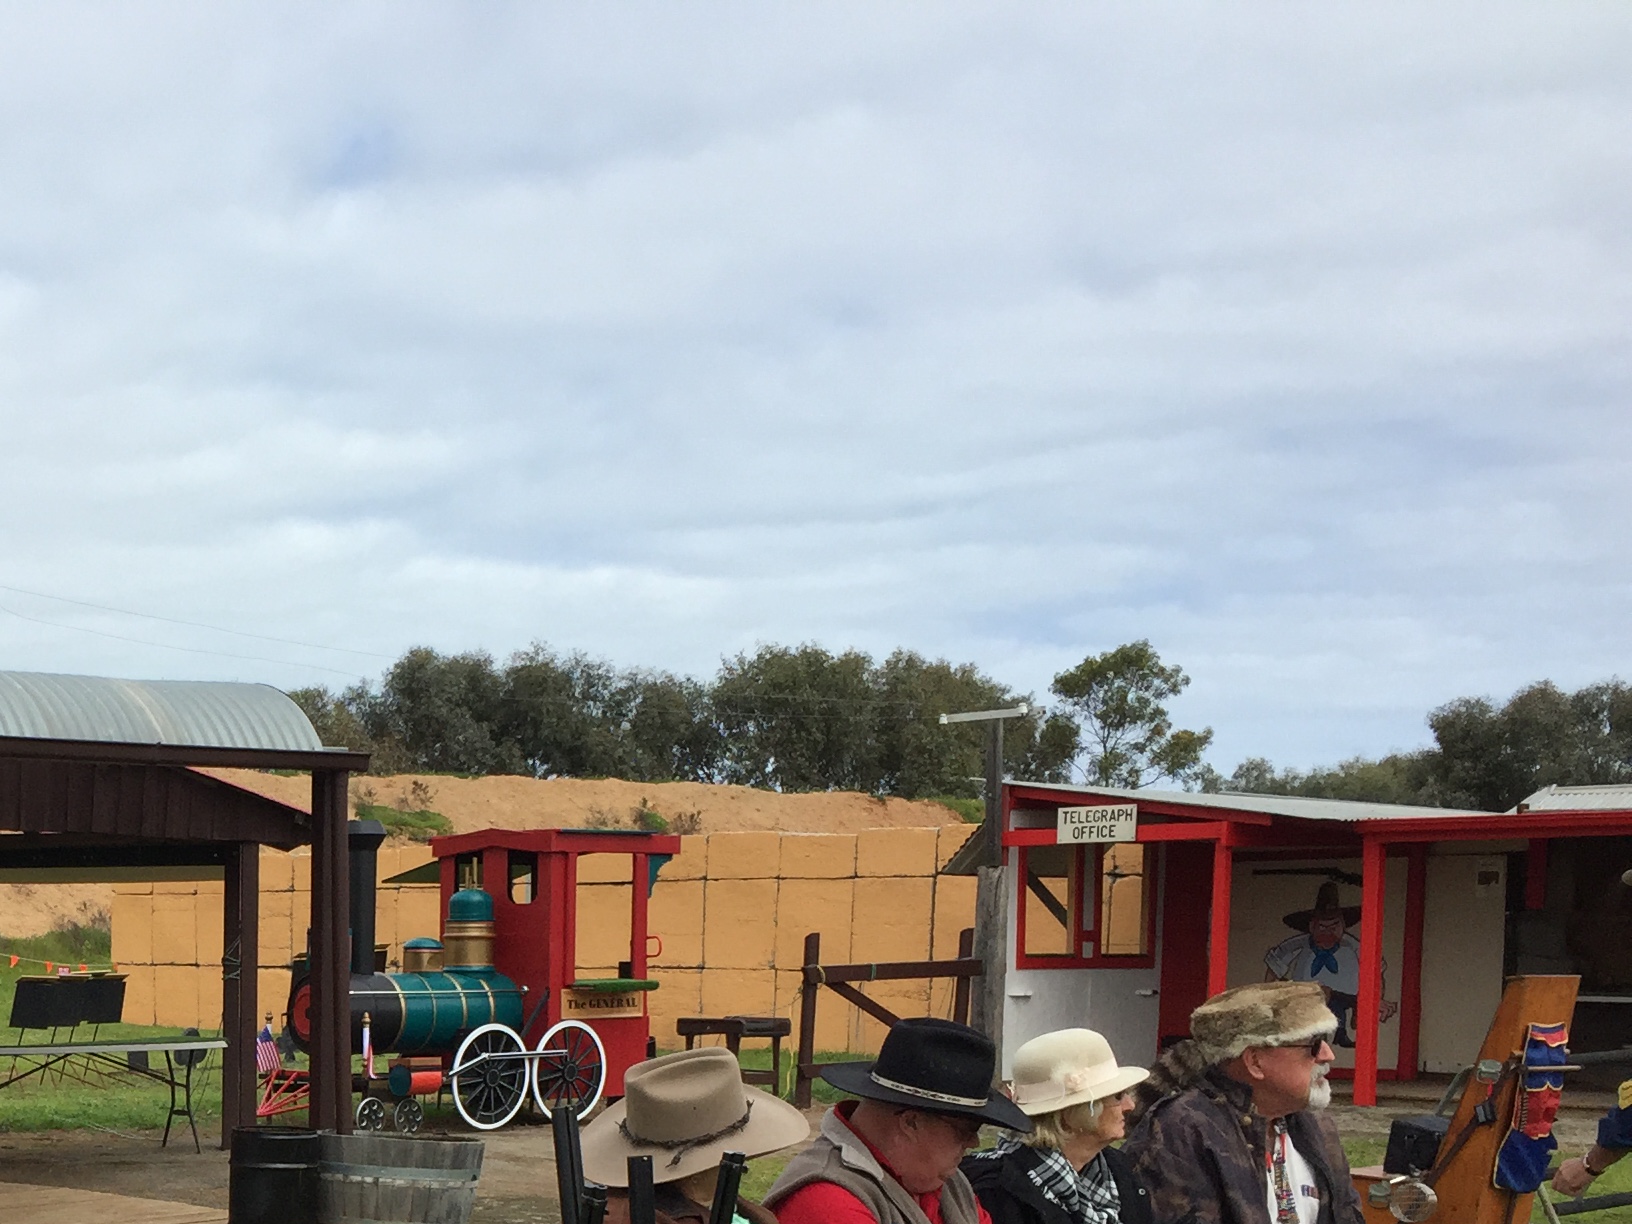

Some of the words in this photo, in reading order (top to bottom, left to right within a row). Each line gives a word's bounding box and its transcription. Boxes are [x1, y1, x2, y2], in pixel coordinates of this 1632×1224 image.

[1063, 808, 1133, 825] TELEGRAPH
[1072, 824, 1116, 839] OFFICE
[567, 999, 587, 1010] The
[589, 998, 638, 1010] GENERAL
